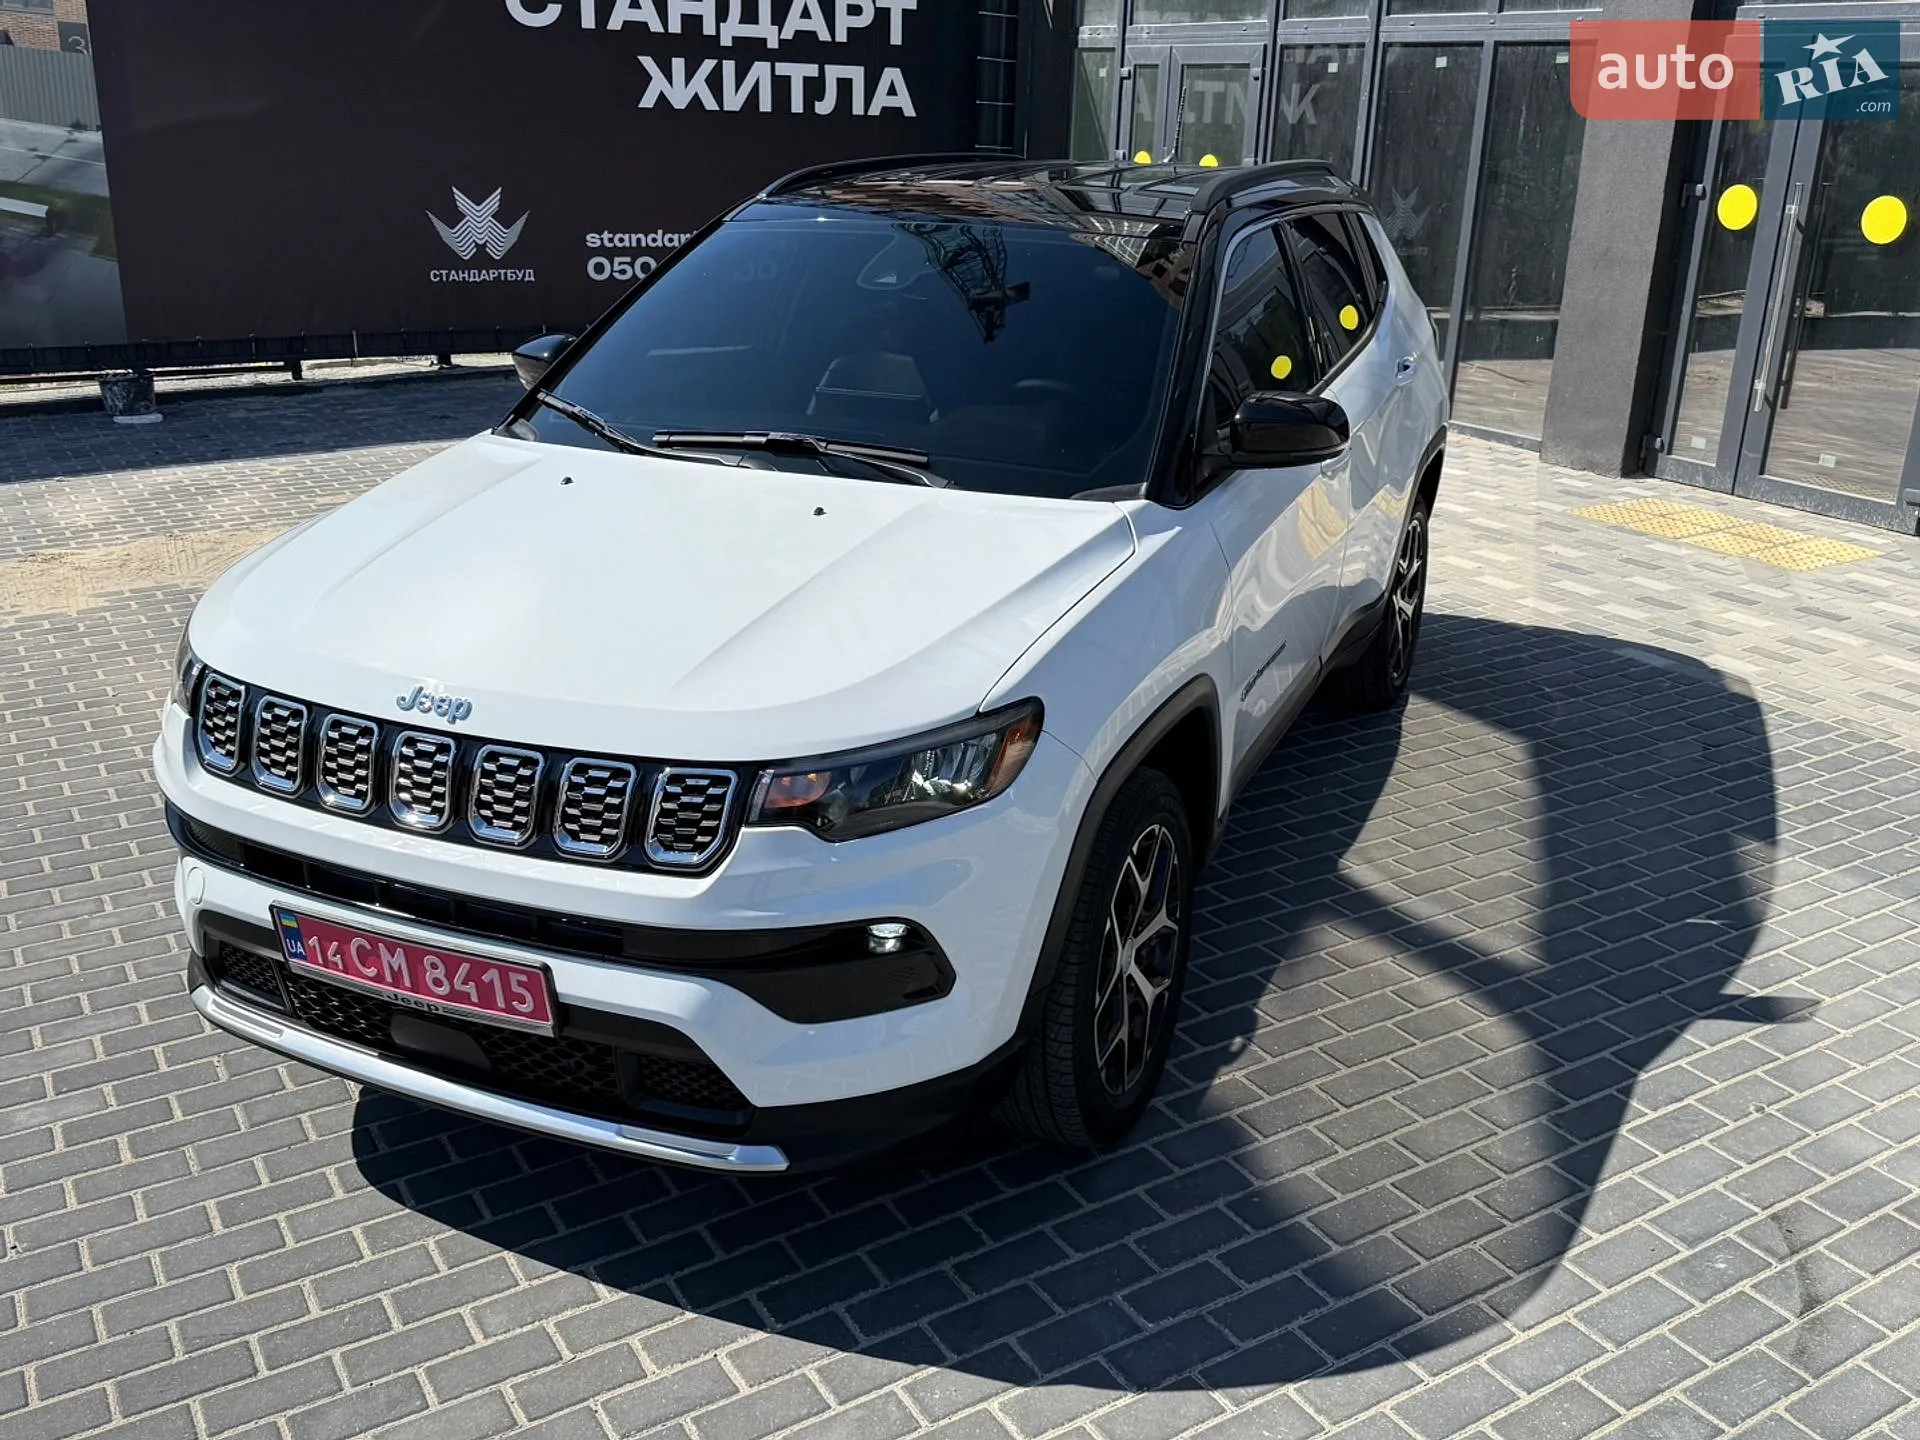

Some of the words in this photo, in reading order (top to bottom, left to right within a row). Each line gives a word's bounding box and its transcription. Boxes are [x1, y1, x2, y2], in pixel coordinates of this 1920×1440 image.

[637, 55, 917, 117] ЖИТЛА
[585, 229, 698, 248] standar
[430, 269, 536, 282] СТАНДАРТБУД
[396, 685, 472, 725] Jeep
[286, 938, 306, 956] UA
[423, 954, 534, 1014] 8415
[386, 992, 440, 1013] Jeep
